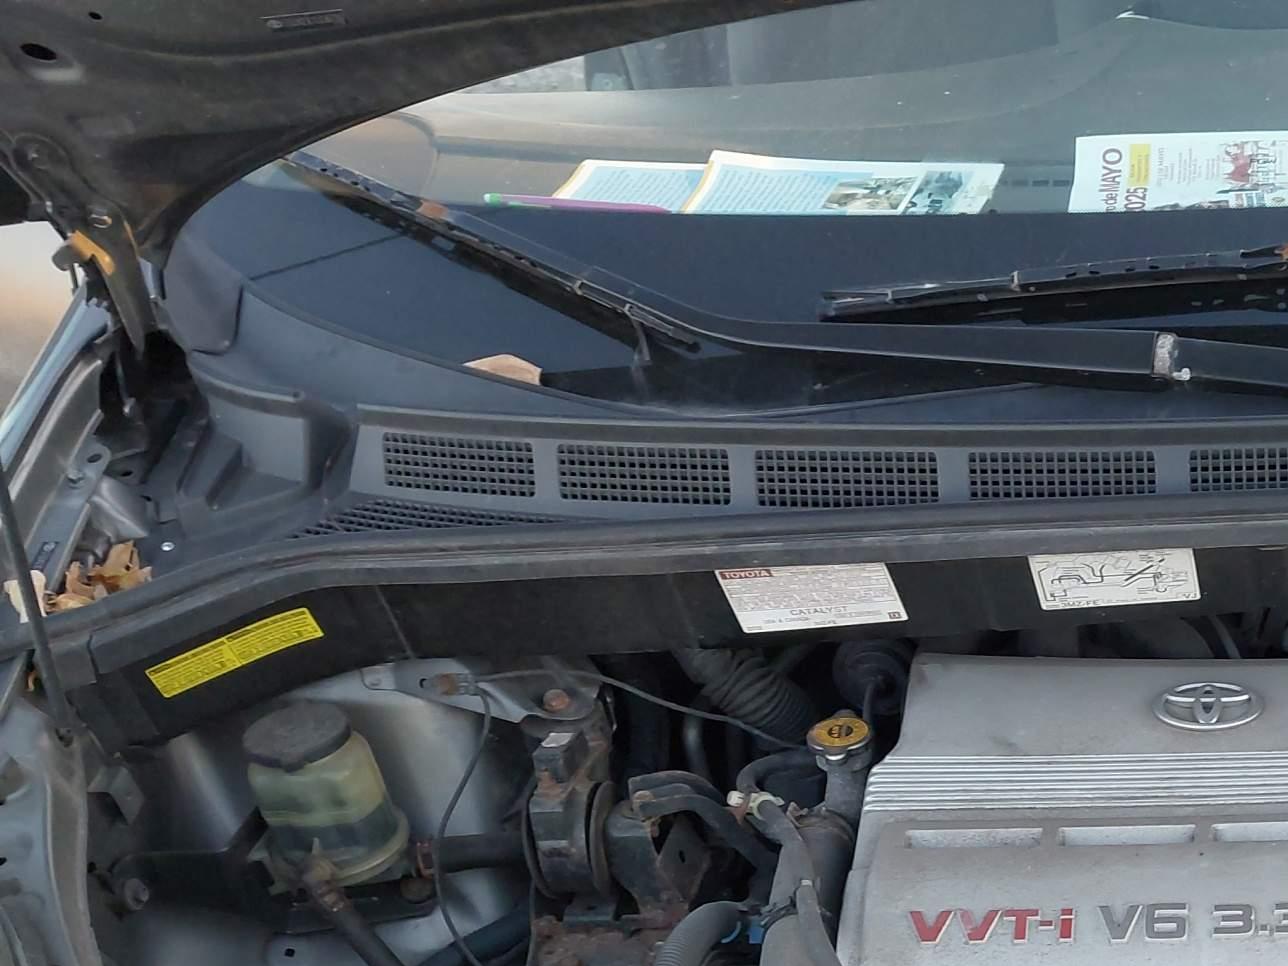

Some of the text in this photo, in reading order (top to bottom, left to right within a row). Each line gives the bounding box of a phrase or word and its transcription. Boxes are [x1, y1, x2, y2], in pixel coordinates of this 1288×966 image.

[1098, 148, 1122, 192] MAYO
[1124, 187, 1147, 212] 025
[724, 570, 770, 579] TOYOTA
[789, 606, 848, 616] CATALYST
[908, 907, 1077, 945] VVT-i
[1099, 902, 1190, 944] V6
